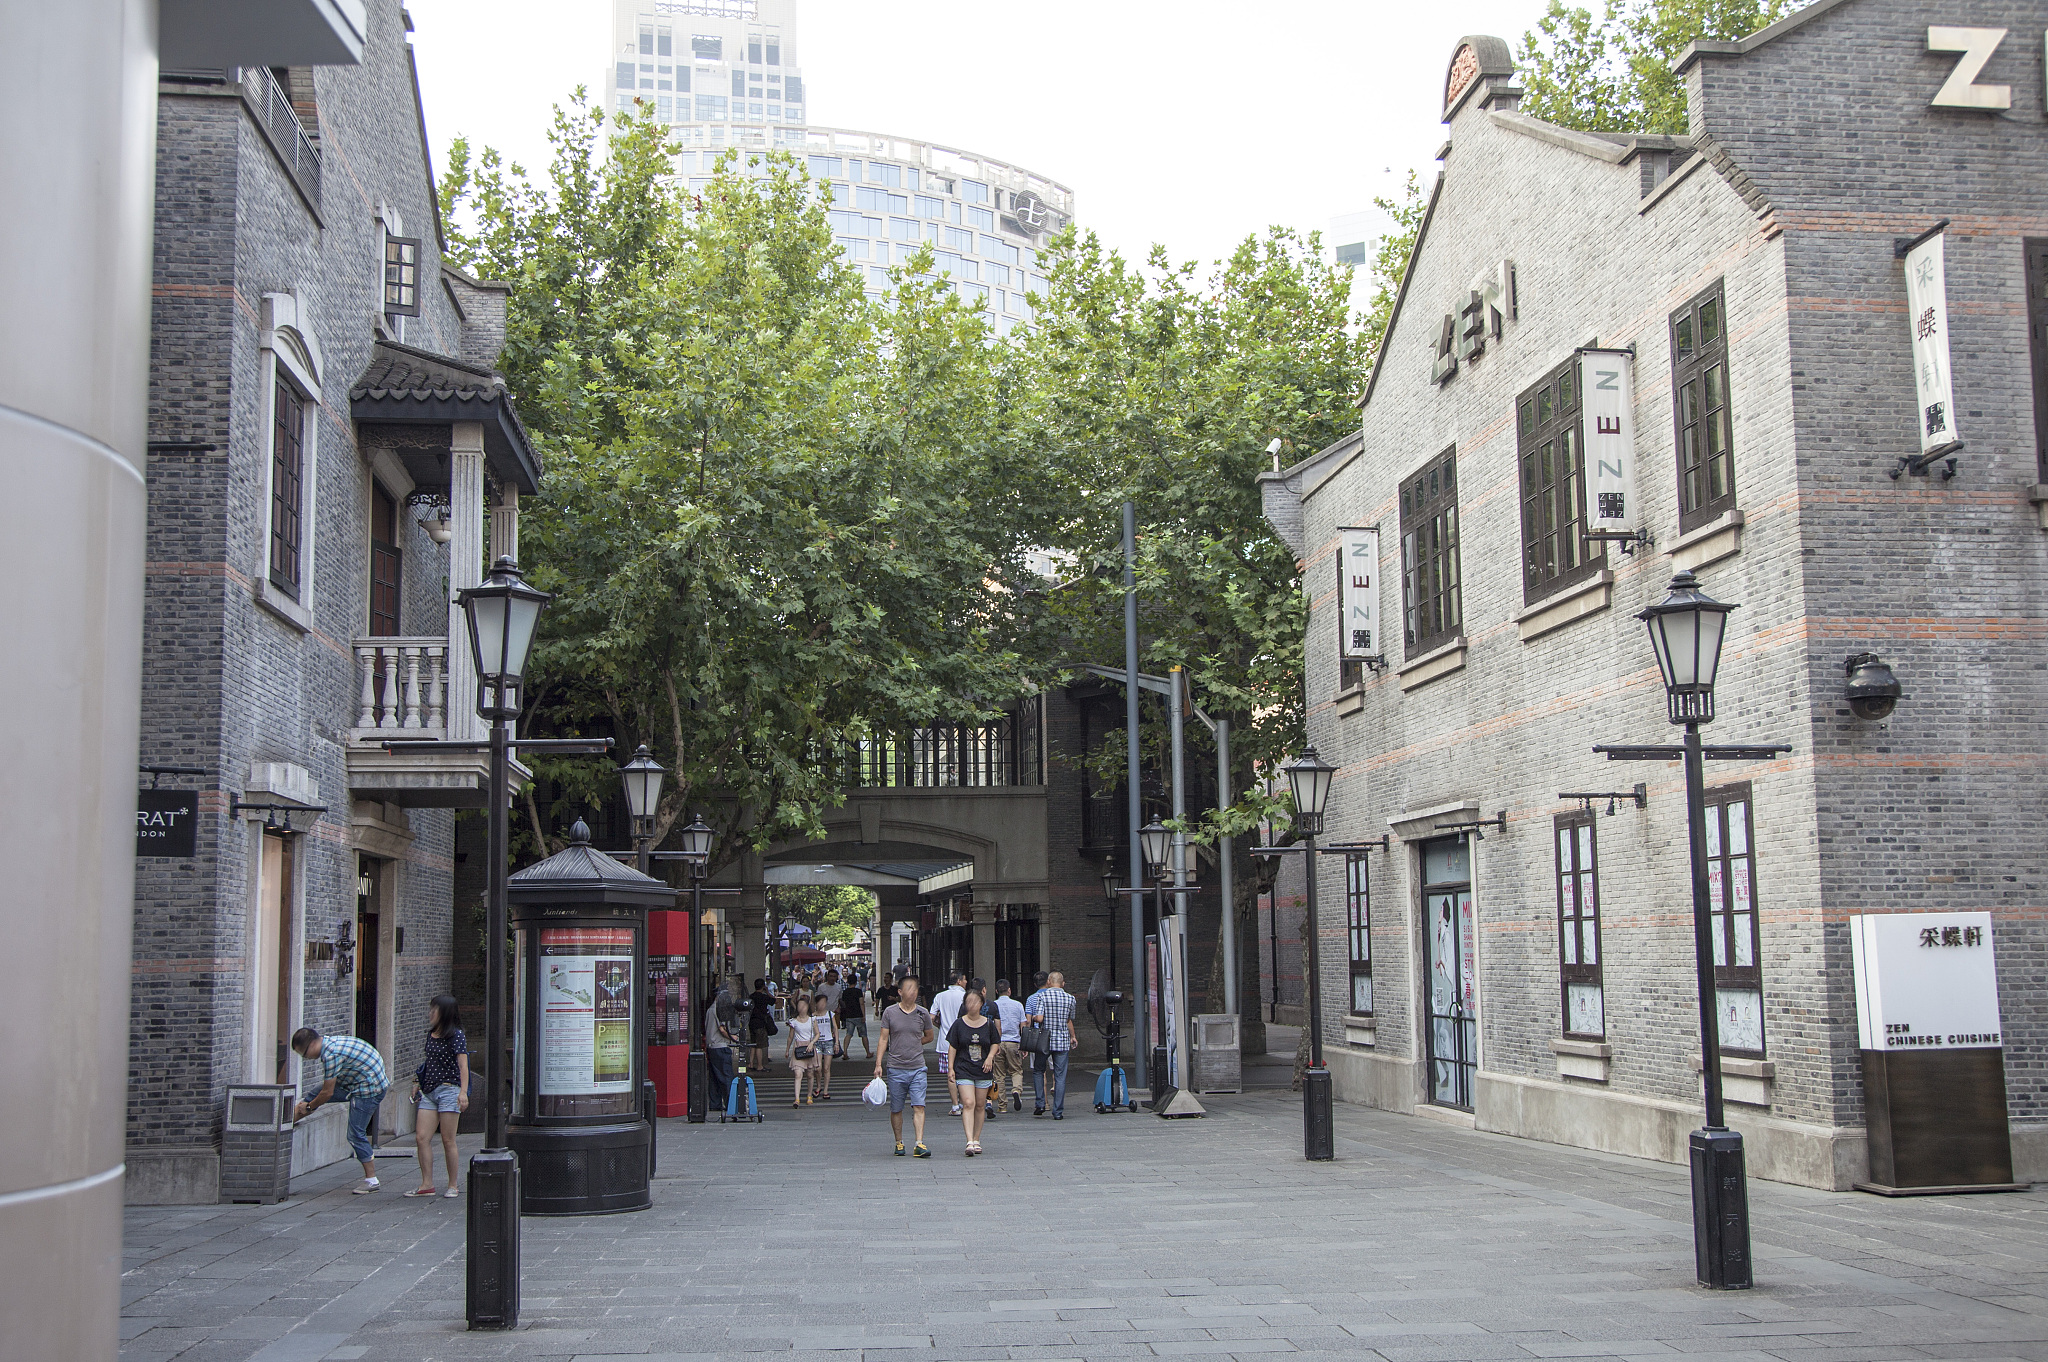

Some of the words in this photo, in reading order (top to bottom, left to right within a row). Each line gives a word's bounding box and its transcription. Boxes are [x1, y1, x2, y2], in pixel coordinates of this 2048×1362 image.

[1927, 25, 2048, 113] Z
[1428, 260, 1512, 385] ZEN
[1916, 255, 1939, 393] 采蝶轩
[1595, 370, 1623, 479] ZEN
[1352, 543, 1370, 620] ZEN
[1919, 926, 1984, 948] 采蝶軒
[1886, 1023, 1910, 1034] ZEN
[1887, 1035, 1942, 1046] CHINESE
[1948, 1033, 2000, 1045] CUISINE
